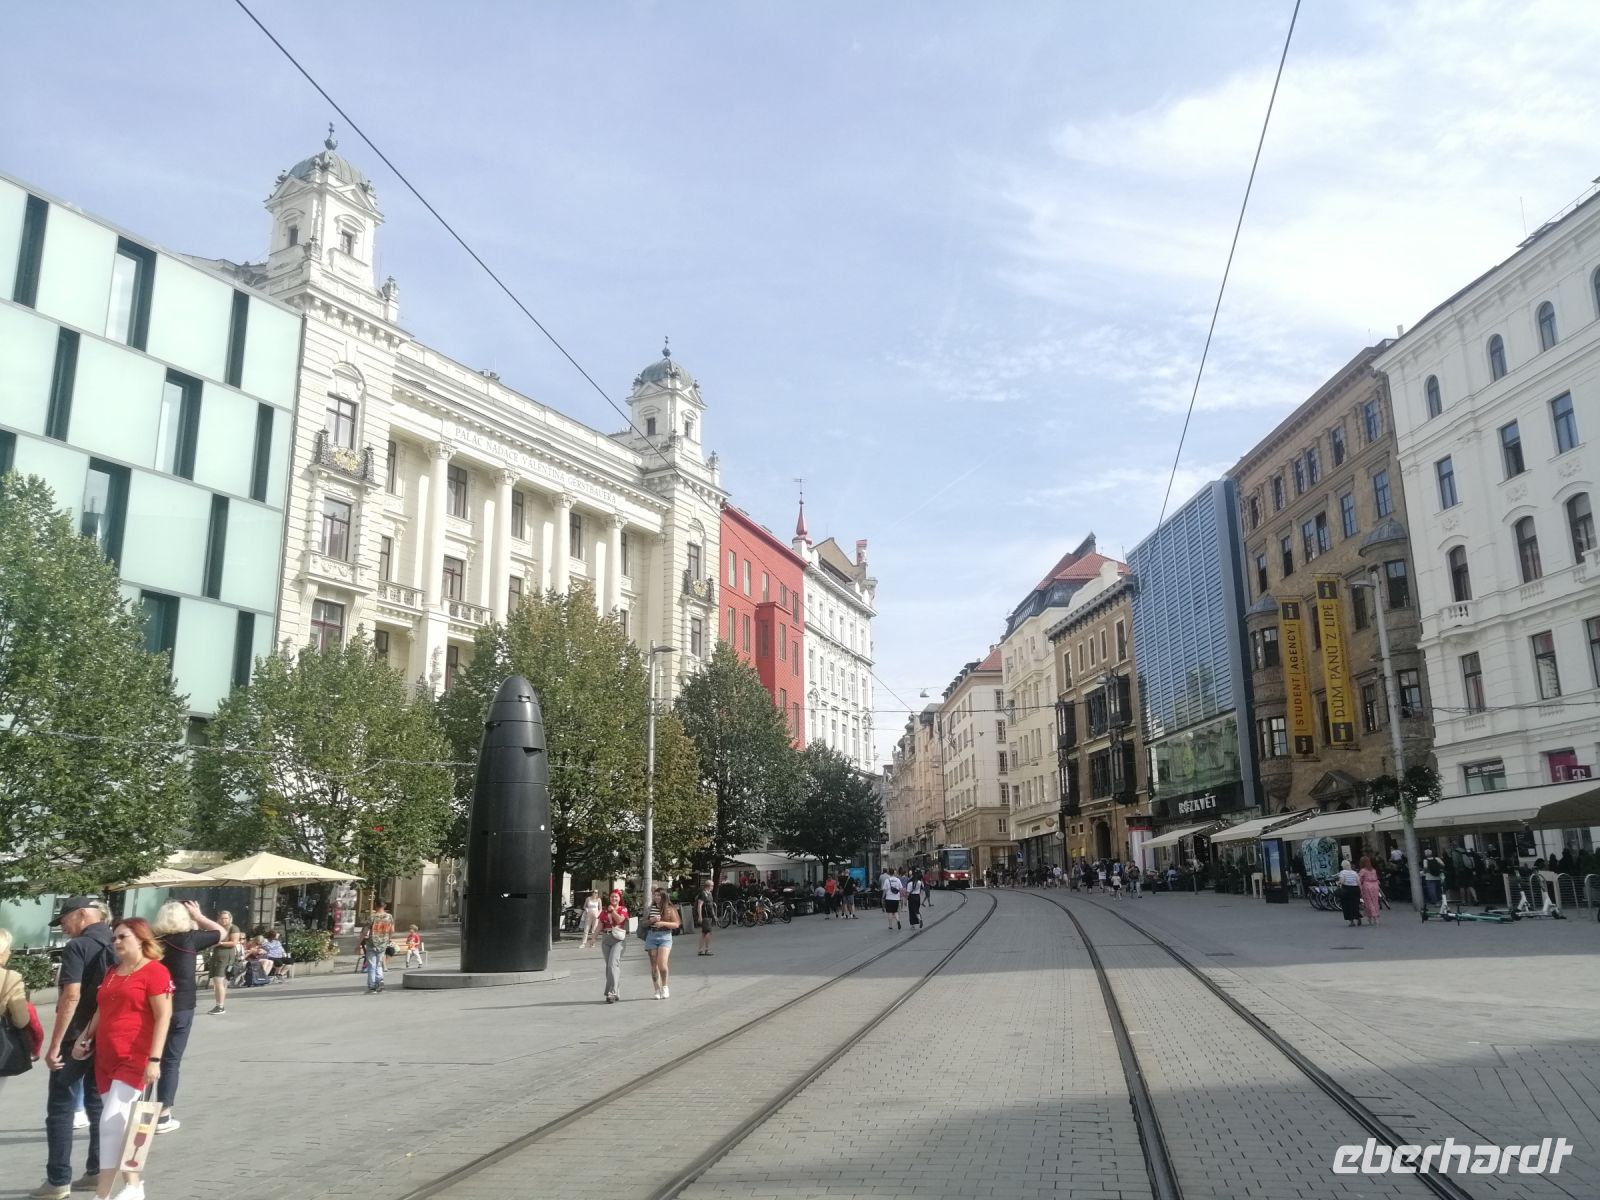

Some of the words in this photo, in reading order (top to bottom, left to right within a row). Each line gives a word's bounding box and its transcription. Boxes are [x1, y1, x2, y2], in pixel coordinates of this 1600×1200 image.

[486, 441, 519, 463] NADACE
[522, 455, 565, 483] VALENTINA
[1287, 628, 1299, 671] AGENCY
[1326, 632, 1337, 641] Z
[1291, 677, 1305, 726] STUDENT
